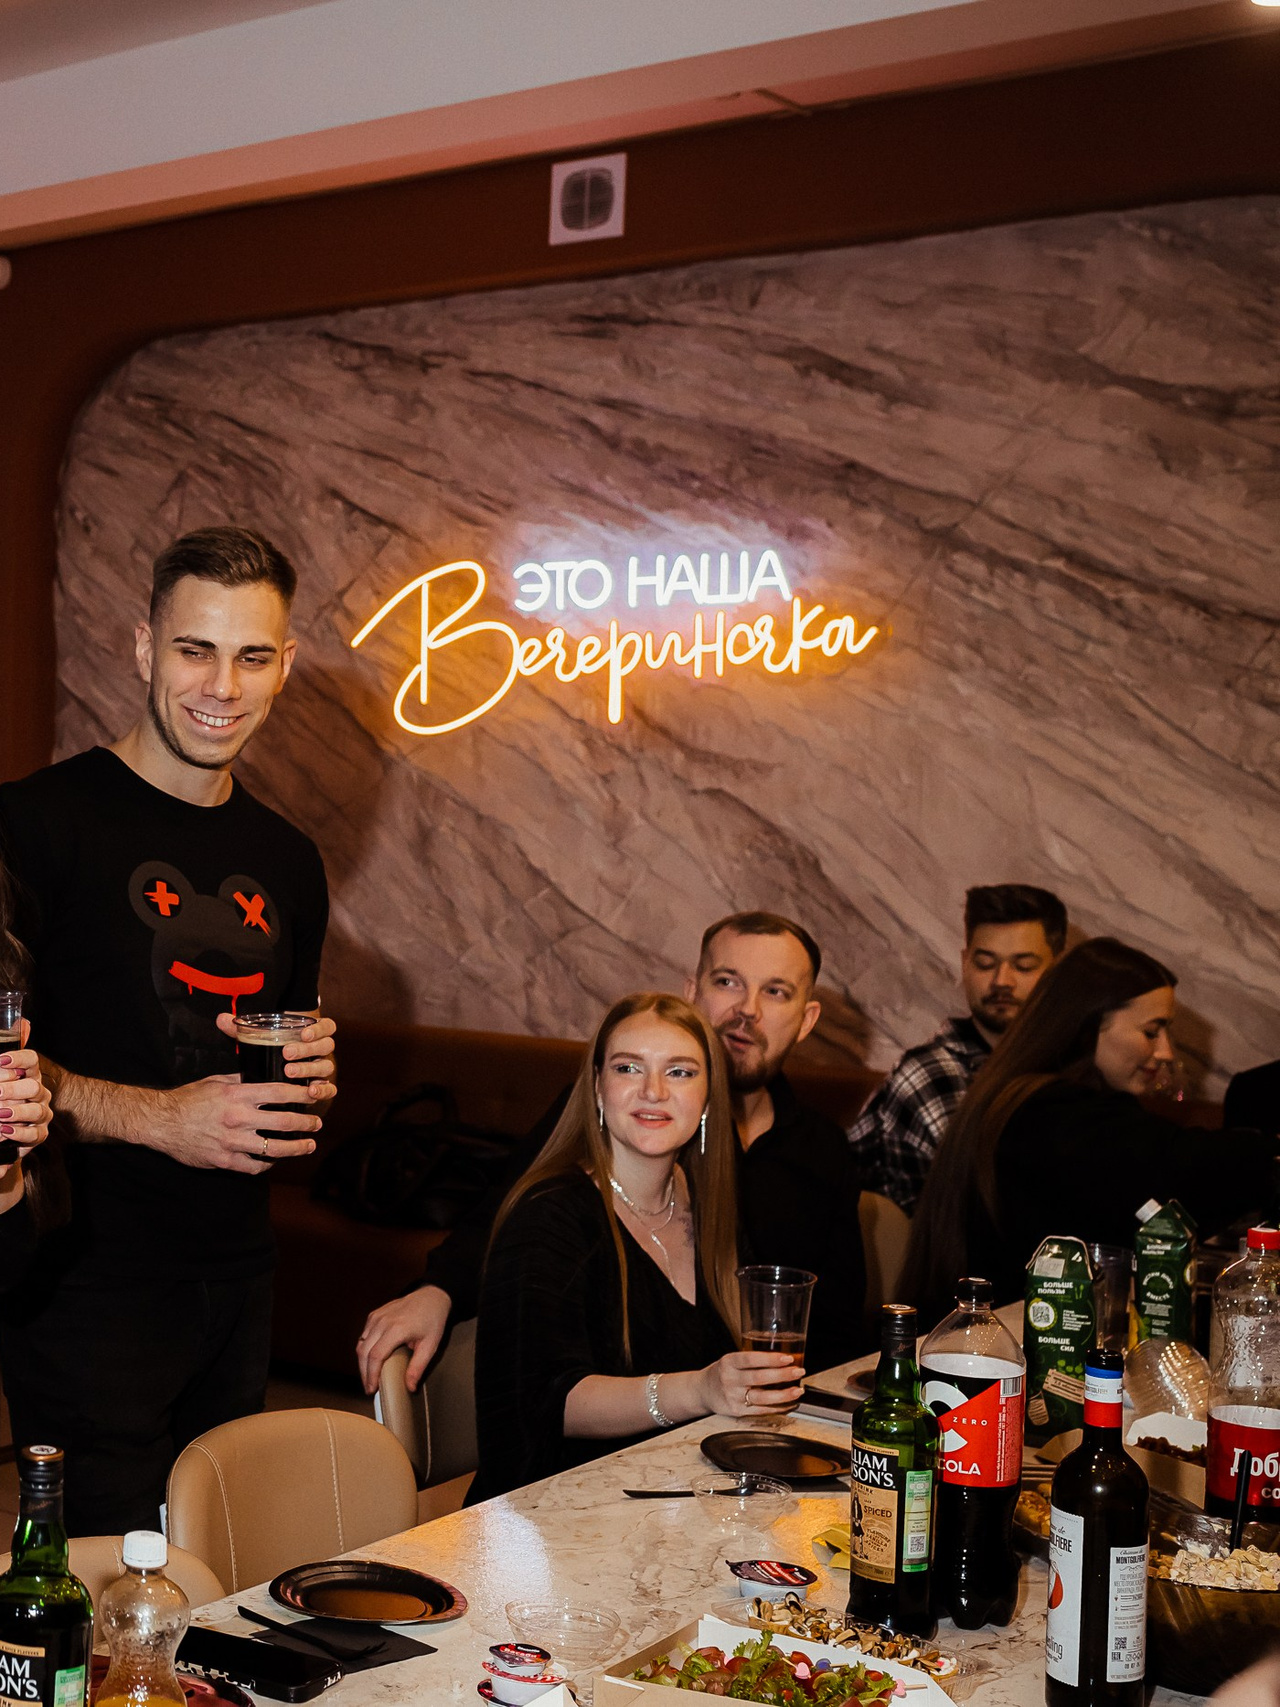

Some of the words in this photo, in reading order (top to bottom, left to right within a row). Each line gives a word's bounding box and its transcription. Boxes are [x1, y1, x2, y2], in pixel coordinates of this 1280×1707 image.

[513, 559, 612, 612] ЭТО
[627, 549, 792, 608] НАША
[350, 560, 879, 735] Вечериночка
[1038, 1336, 1071, 1345] БОЛЬШЕ
[952, 1416, 988, 1426] ZERO
[937, 1458, 981, 1476] COLA
[1230, 1447, 1280, 1483] Доб
[863, 1505, 892, 1518] SPICED
